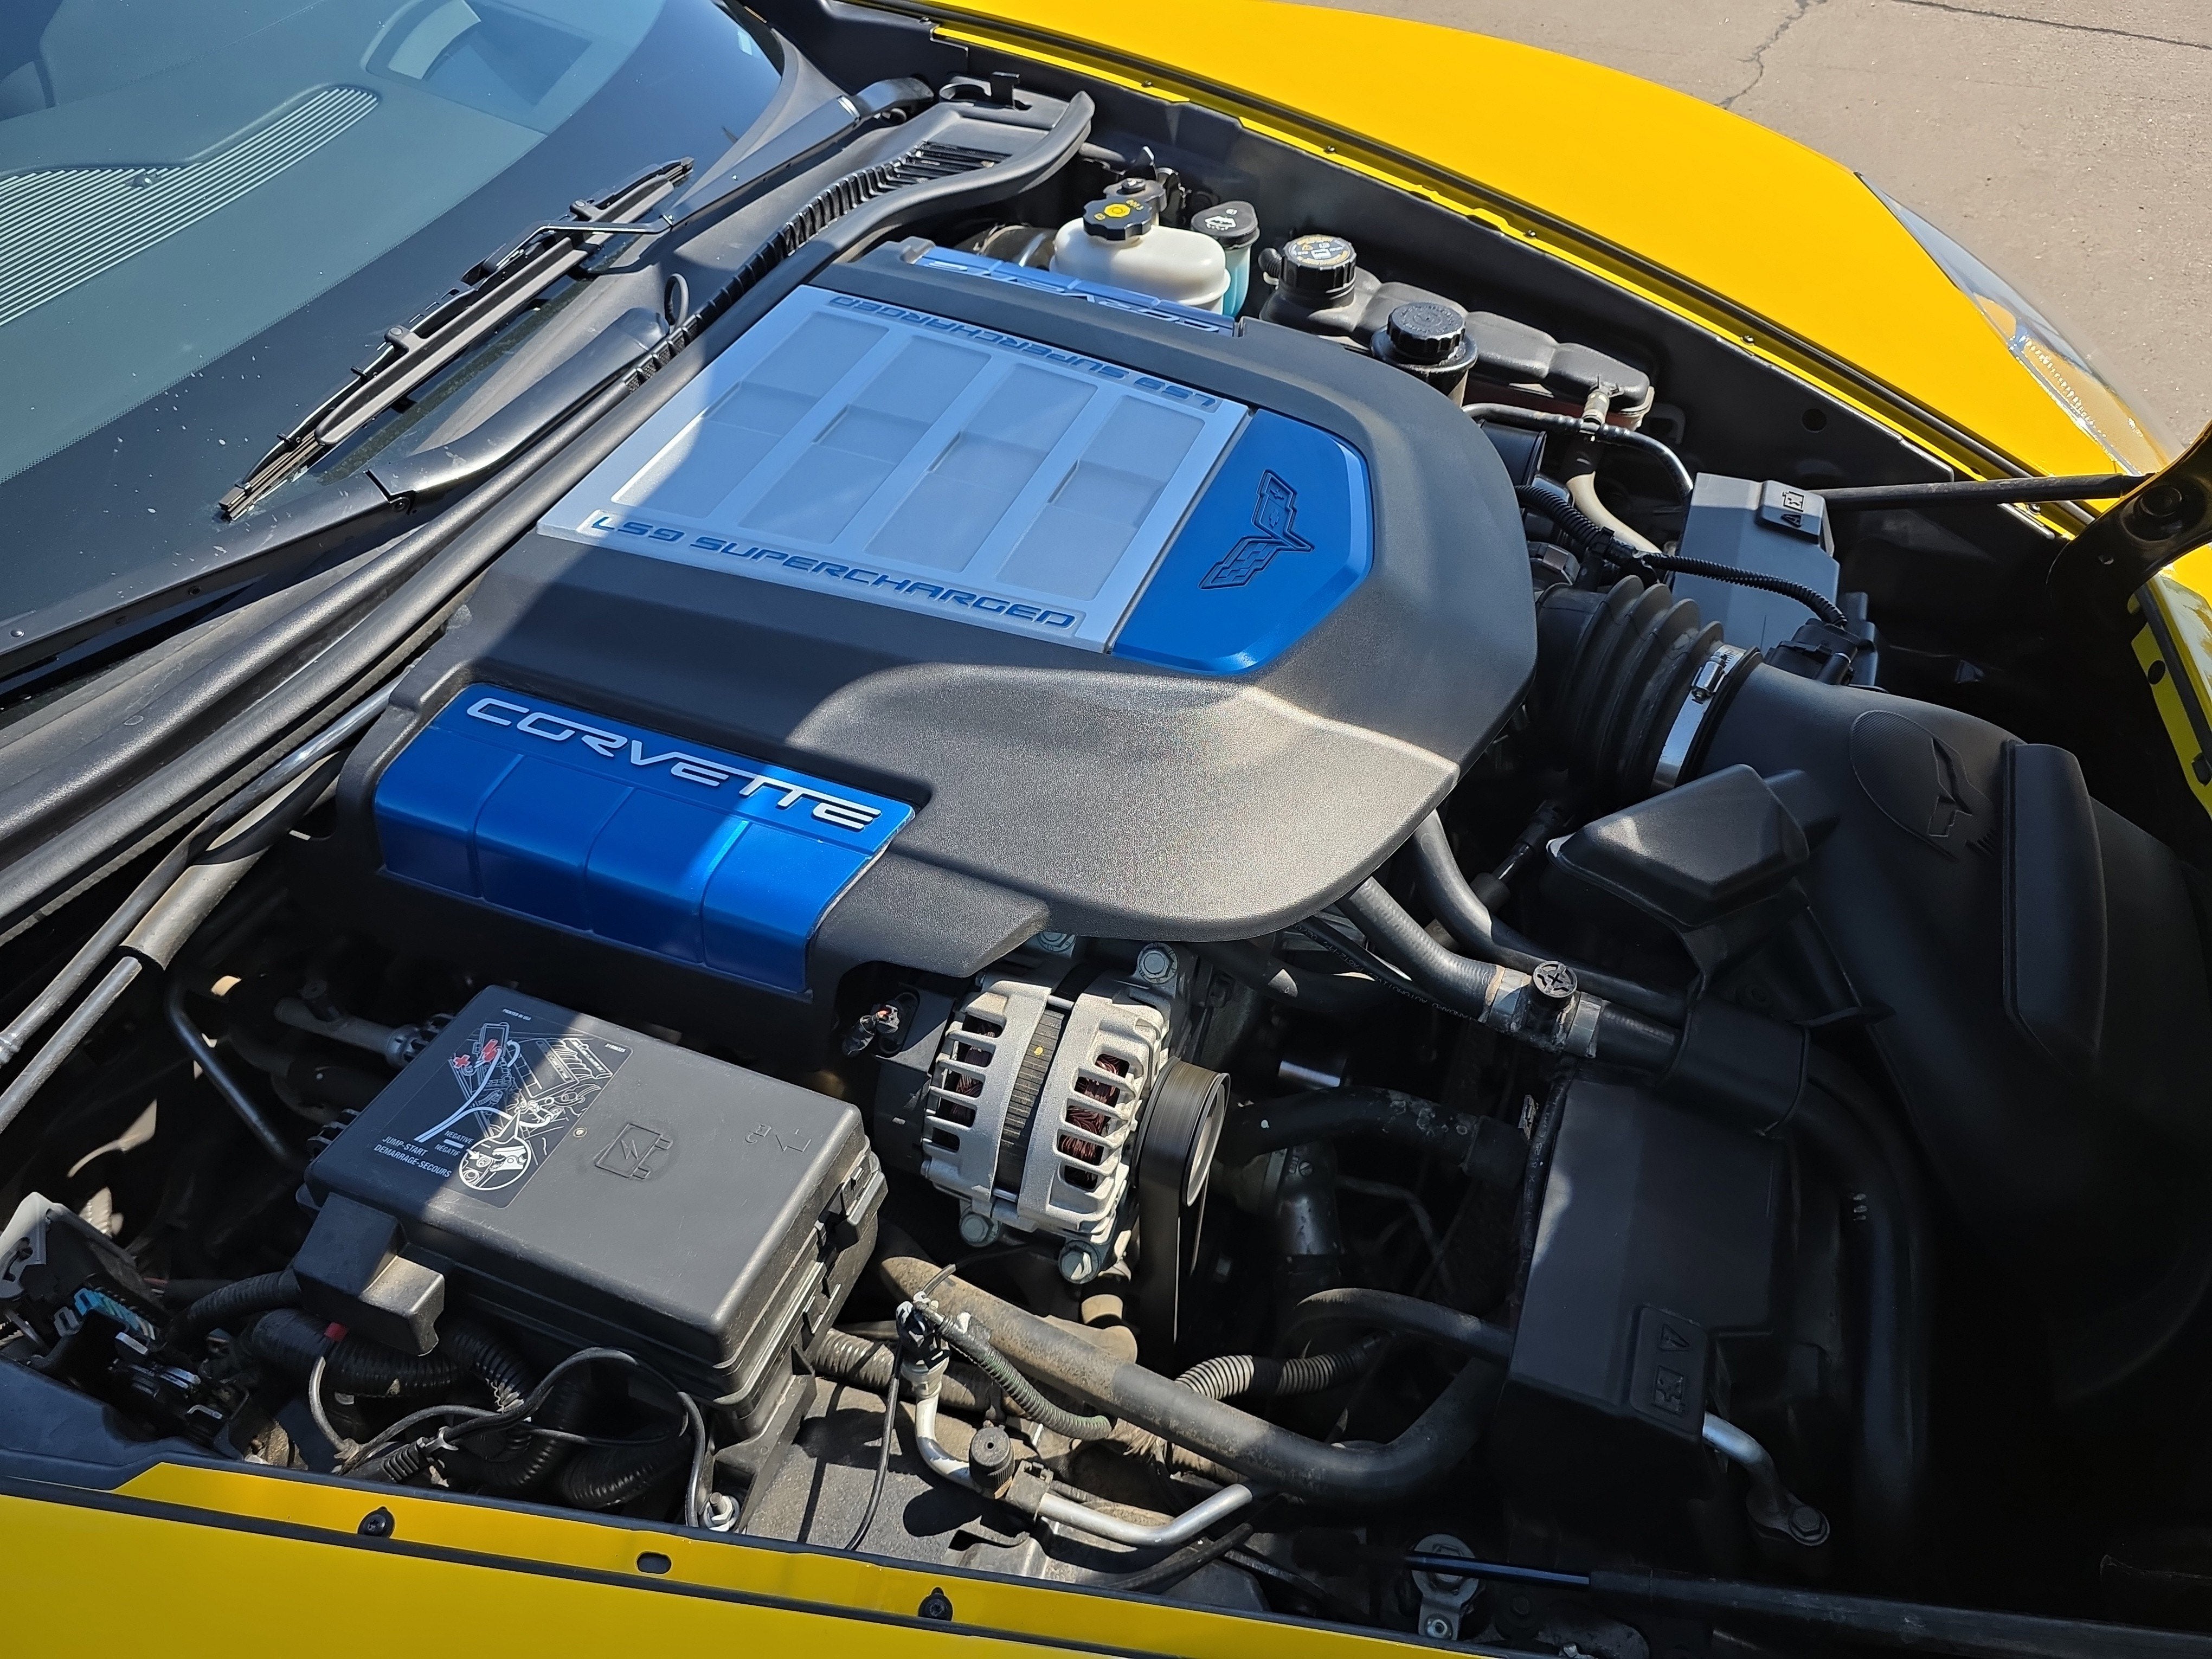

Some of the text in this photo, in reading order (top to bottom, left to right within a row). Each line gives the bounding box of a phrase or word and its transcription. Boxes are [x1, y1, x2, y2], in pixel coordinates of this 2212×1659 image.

[829, 296, 1217, 407] LS9 SUPERCHARGED
[591, 516, 1076, 629] LS9 SUPERCHARGED
[466, 697, 882, 830] CORVETTE
[374, 1143, 453, 1178] DEMARRAGE-SECOURS
[382, 1136, 429, 1157] JUMP-START
[444, 1130, 474, 1144] NEGATIVE
